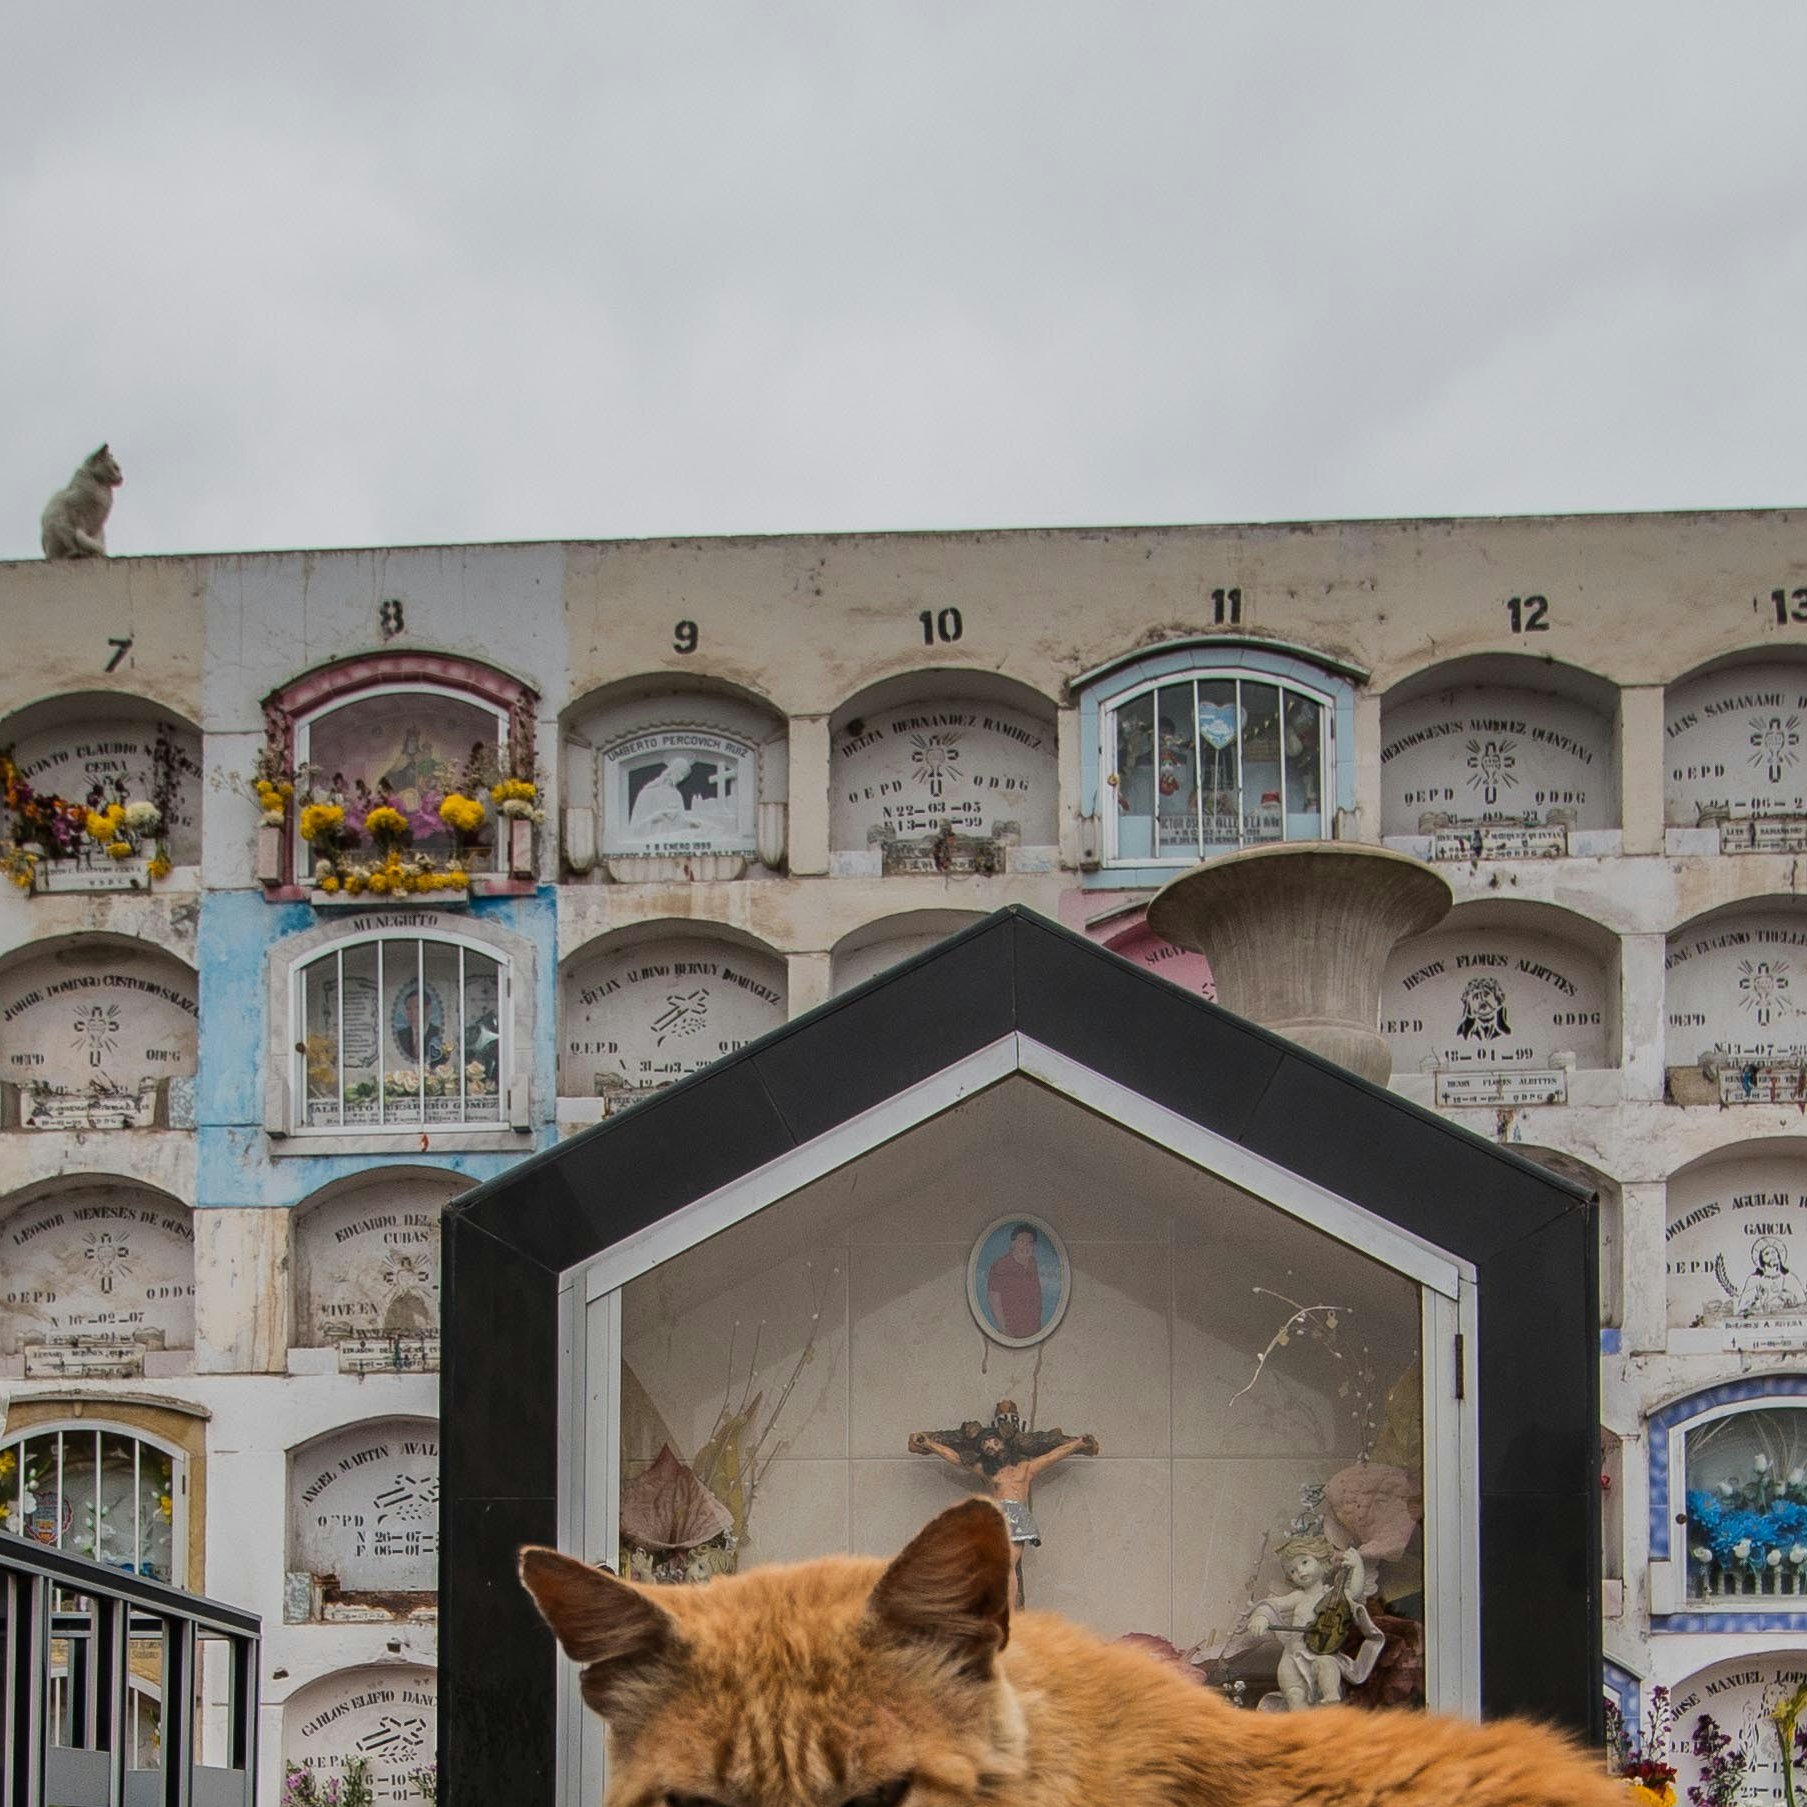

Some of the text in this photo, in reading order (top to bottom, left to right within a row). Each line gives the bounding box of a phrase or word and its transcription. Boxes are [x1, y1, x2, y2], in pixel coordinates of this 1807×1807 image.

[380, 600, 405, 635] 8
[1211, 588, 1242, 625] 11
[1507, 595, 1550, 633] 12
[673, 620, 699, 655] 9
[919, 607, 964, 646] 10
[105, 637, 134, 673] 7
[842, 713, 1042, 758] DELIA HERNANDEZ RAMIREZ
[1666, 713, 1698, 739] LUIS
[76, 743, 138, 760] CLAUDIO
[607, 735, 749, 762] UMBERTO PERCOVICH RUIZ
[84, 760, 128, 773] CERNA
[1402, 959, 1445, 991] HENRY
[1456, 953, 1508, 969] FLORES
[1732, 1193, 1789, 1211] AGUILAR
[13, 1206, 159, 1246] LEONOR MENESES DE
[334, 1214, 429, 1243] EDUARDO DEL
[1744, 1223, 1793, 1236] GARCIA
[302, 1472, 337, 1508] ANGEL
[338, 1444, 389, 1473] MARTIN
[1671, 1693, 1701, 1722] JOSE
[1705, 1670, 1765, 1697] MANUEL
[301, 1703, 350, 1738] CARLOS
